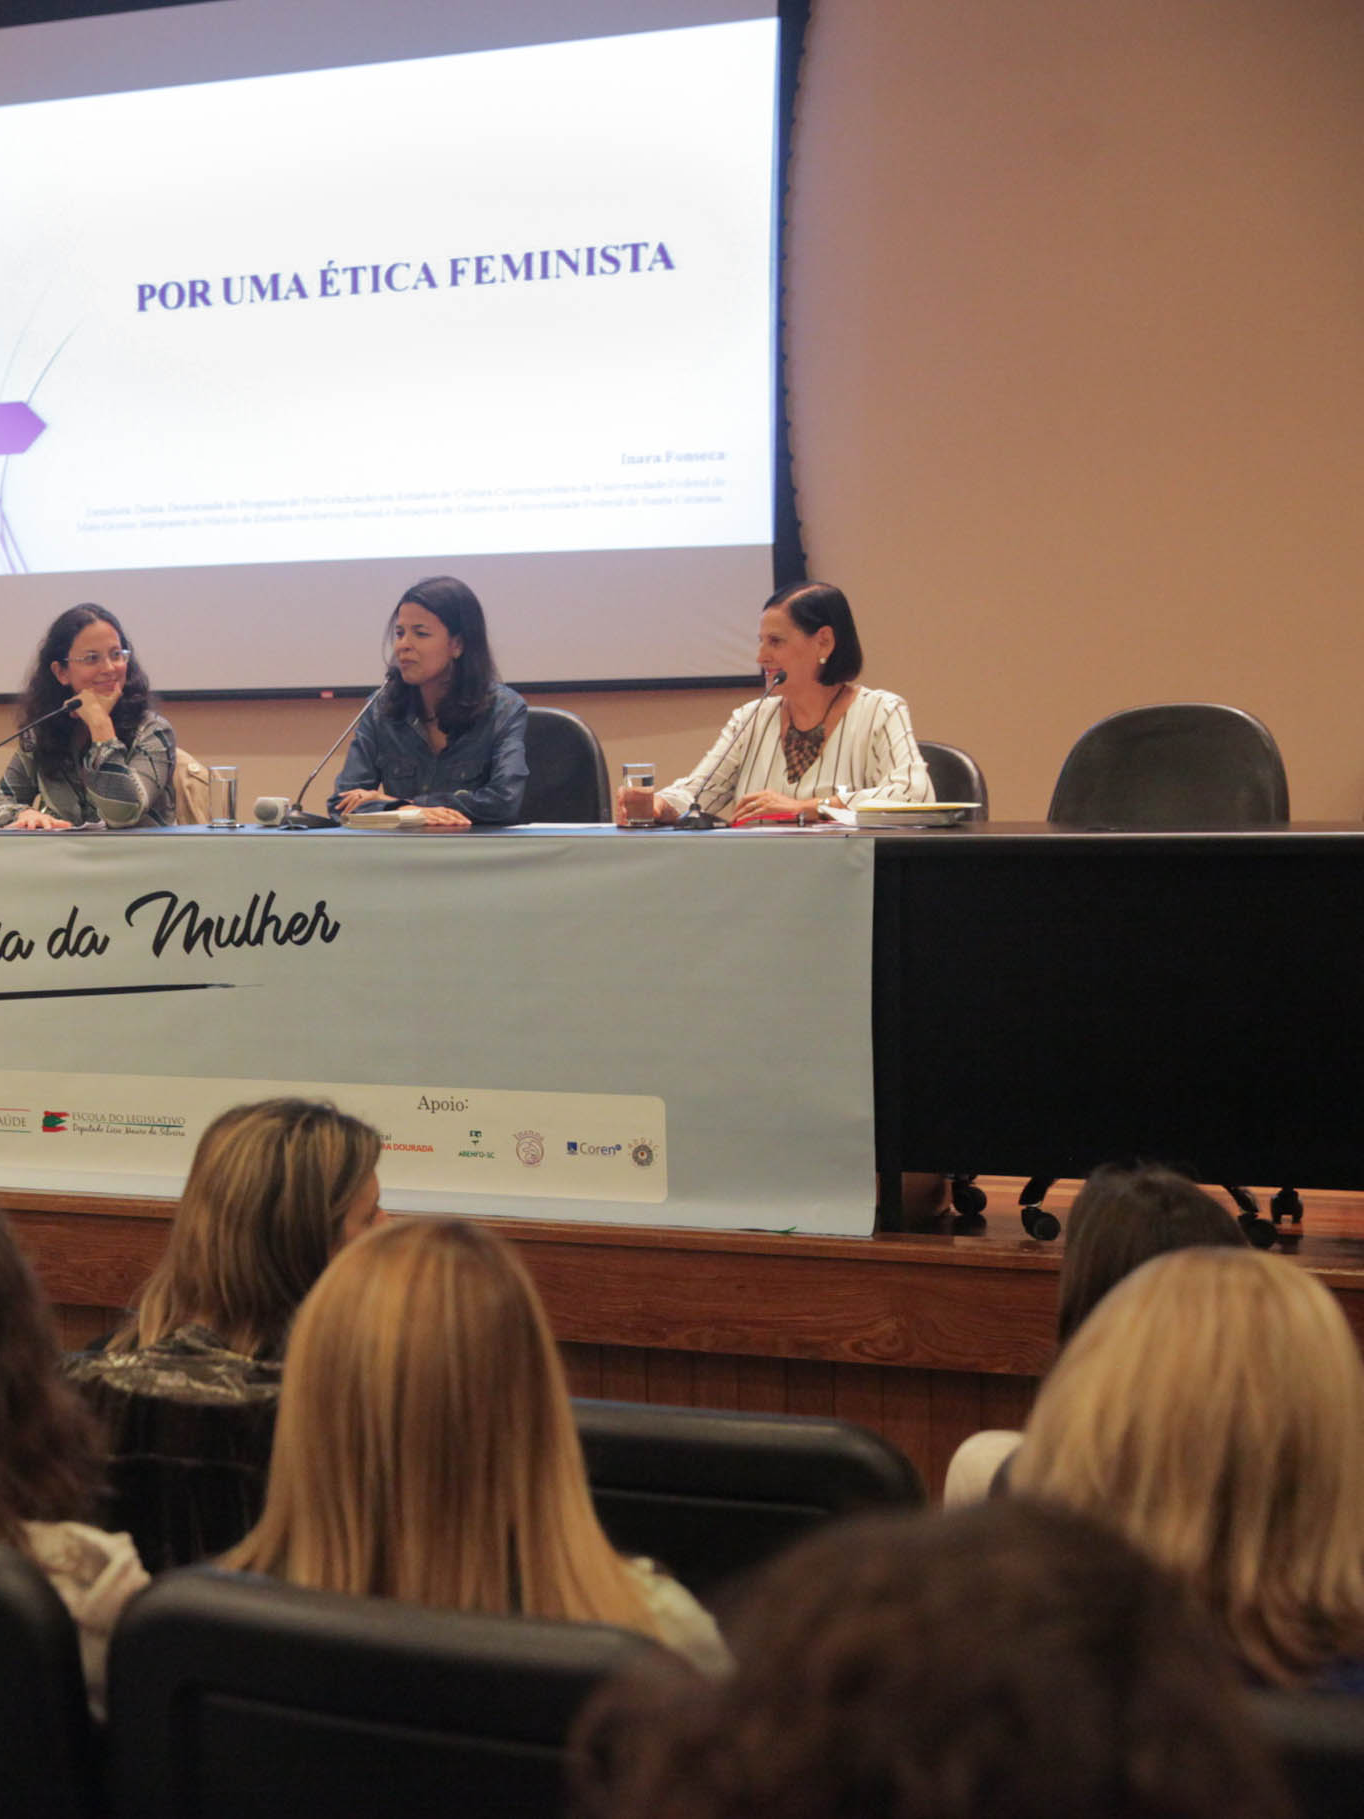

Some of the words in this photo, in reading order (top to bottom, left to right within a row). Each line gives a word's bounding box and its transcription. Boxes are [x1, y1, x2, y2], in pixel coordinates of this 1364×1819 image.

[137, 279, 212, 312] POR
[222, 271, 308, 305] UMA
[318, 259, 438, 298] ÉTICA
[449, 241, 676, 287] FEMINISTA
[47, 904, 109, 959] da
[124, 889, 341, 958] Mulher
[417, 1096, 468, 1114] Apoio:
[72, 1112, 107, 1121] ESCOLA
[109, 1113, 124, 1122] DO
[127, 1114, 186, 1125] LEGISLATIVO
[394, 1144, 434, 1153] DOURADA
